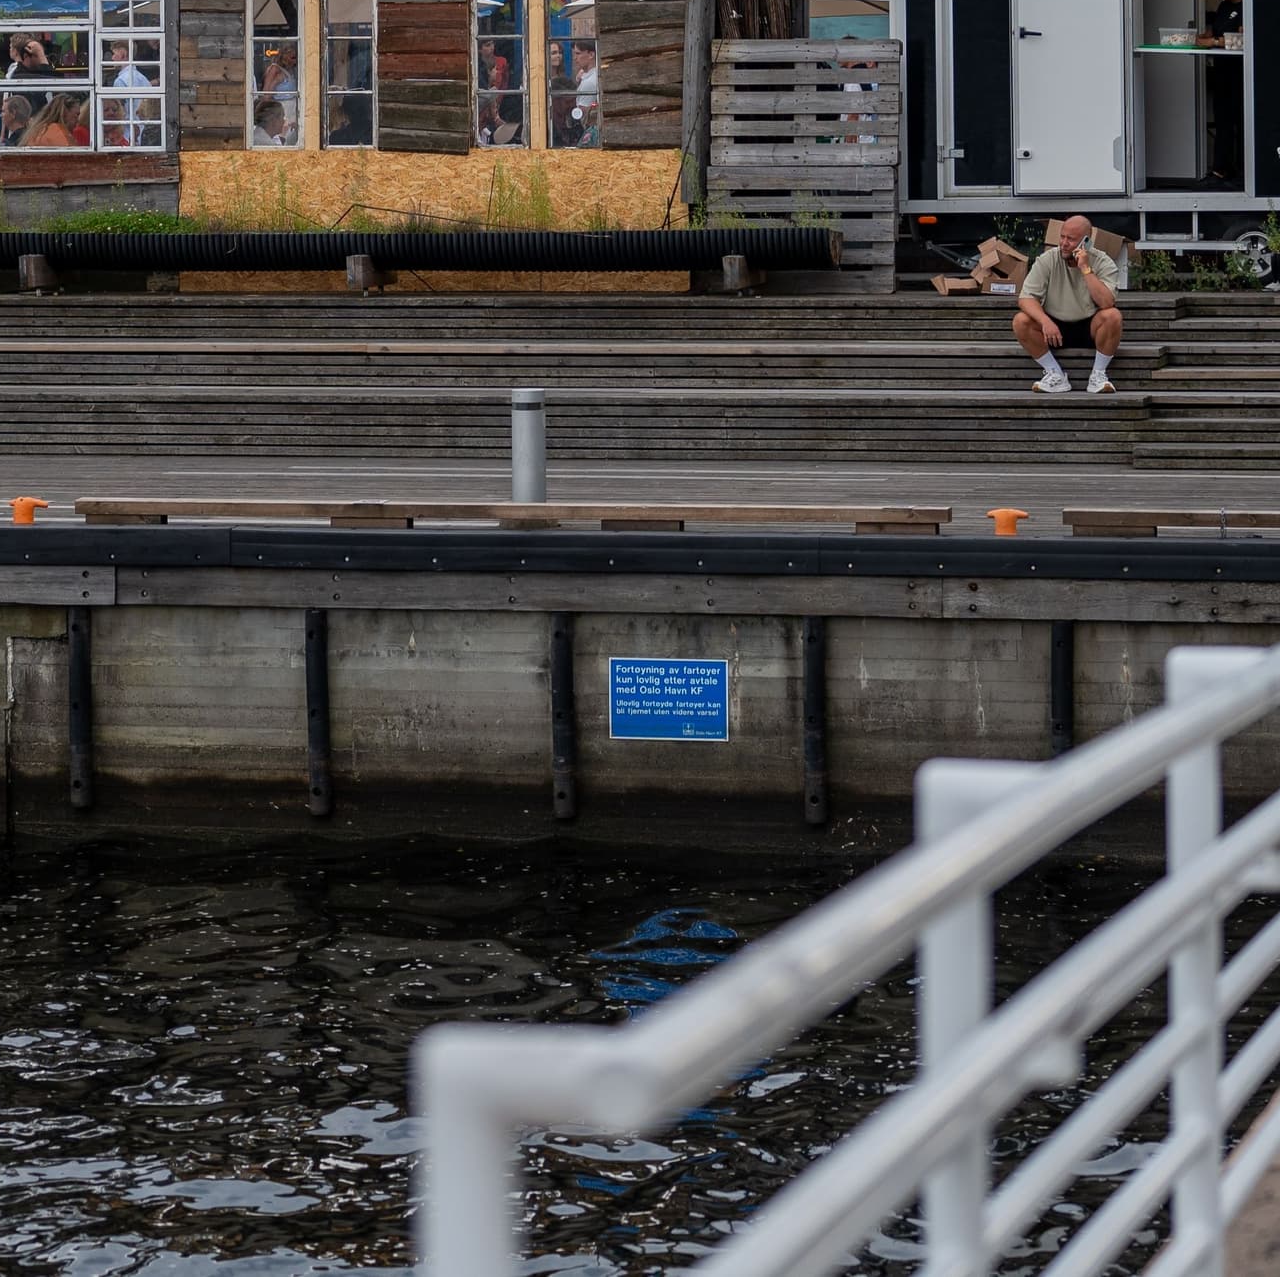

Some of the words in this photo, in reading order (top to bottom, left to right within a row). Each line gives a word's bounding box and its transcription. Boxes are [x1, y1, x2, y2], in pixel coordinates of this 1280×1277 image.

[616, 675, 632, 684] kun
[636, 676, 660, 685] lovlig
[663, 677, 686, 685] etter
[689, 677, 718, 685] avtale
[616, 686, 636, 694] med
[640, 686, 660, 694] Oslo
[664, 686, 687, 695] Havn
[691, 687, 703, 695] KF
[616, 699, 640, 708] Ulovlig
[628, 708, 651, 716] fjernet
